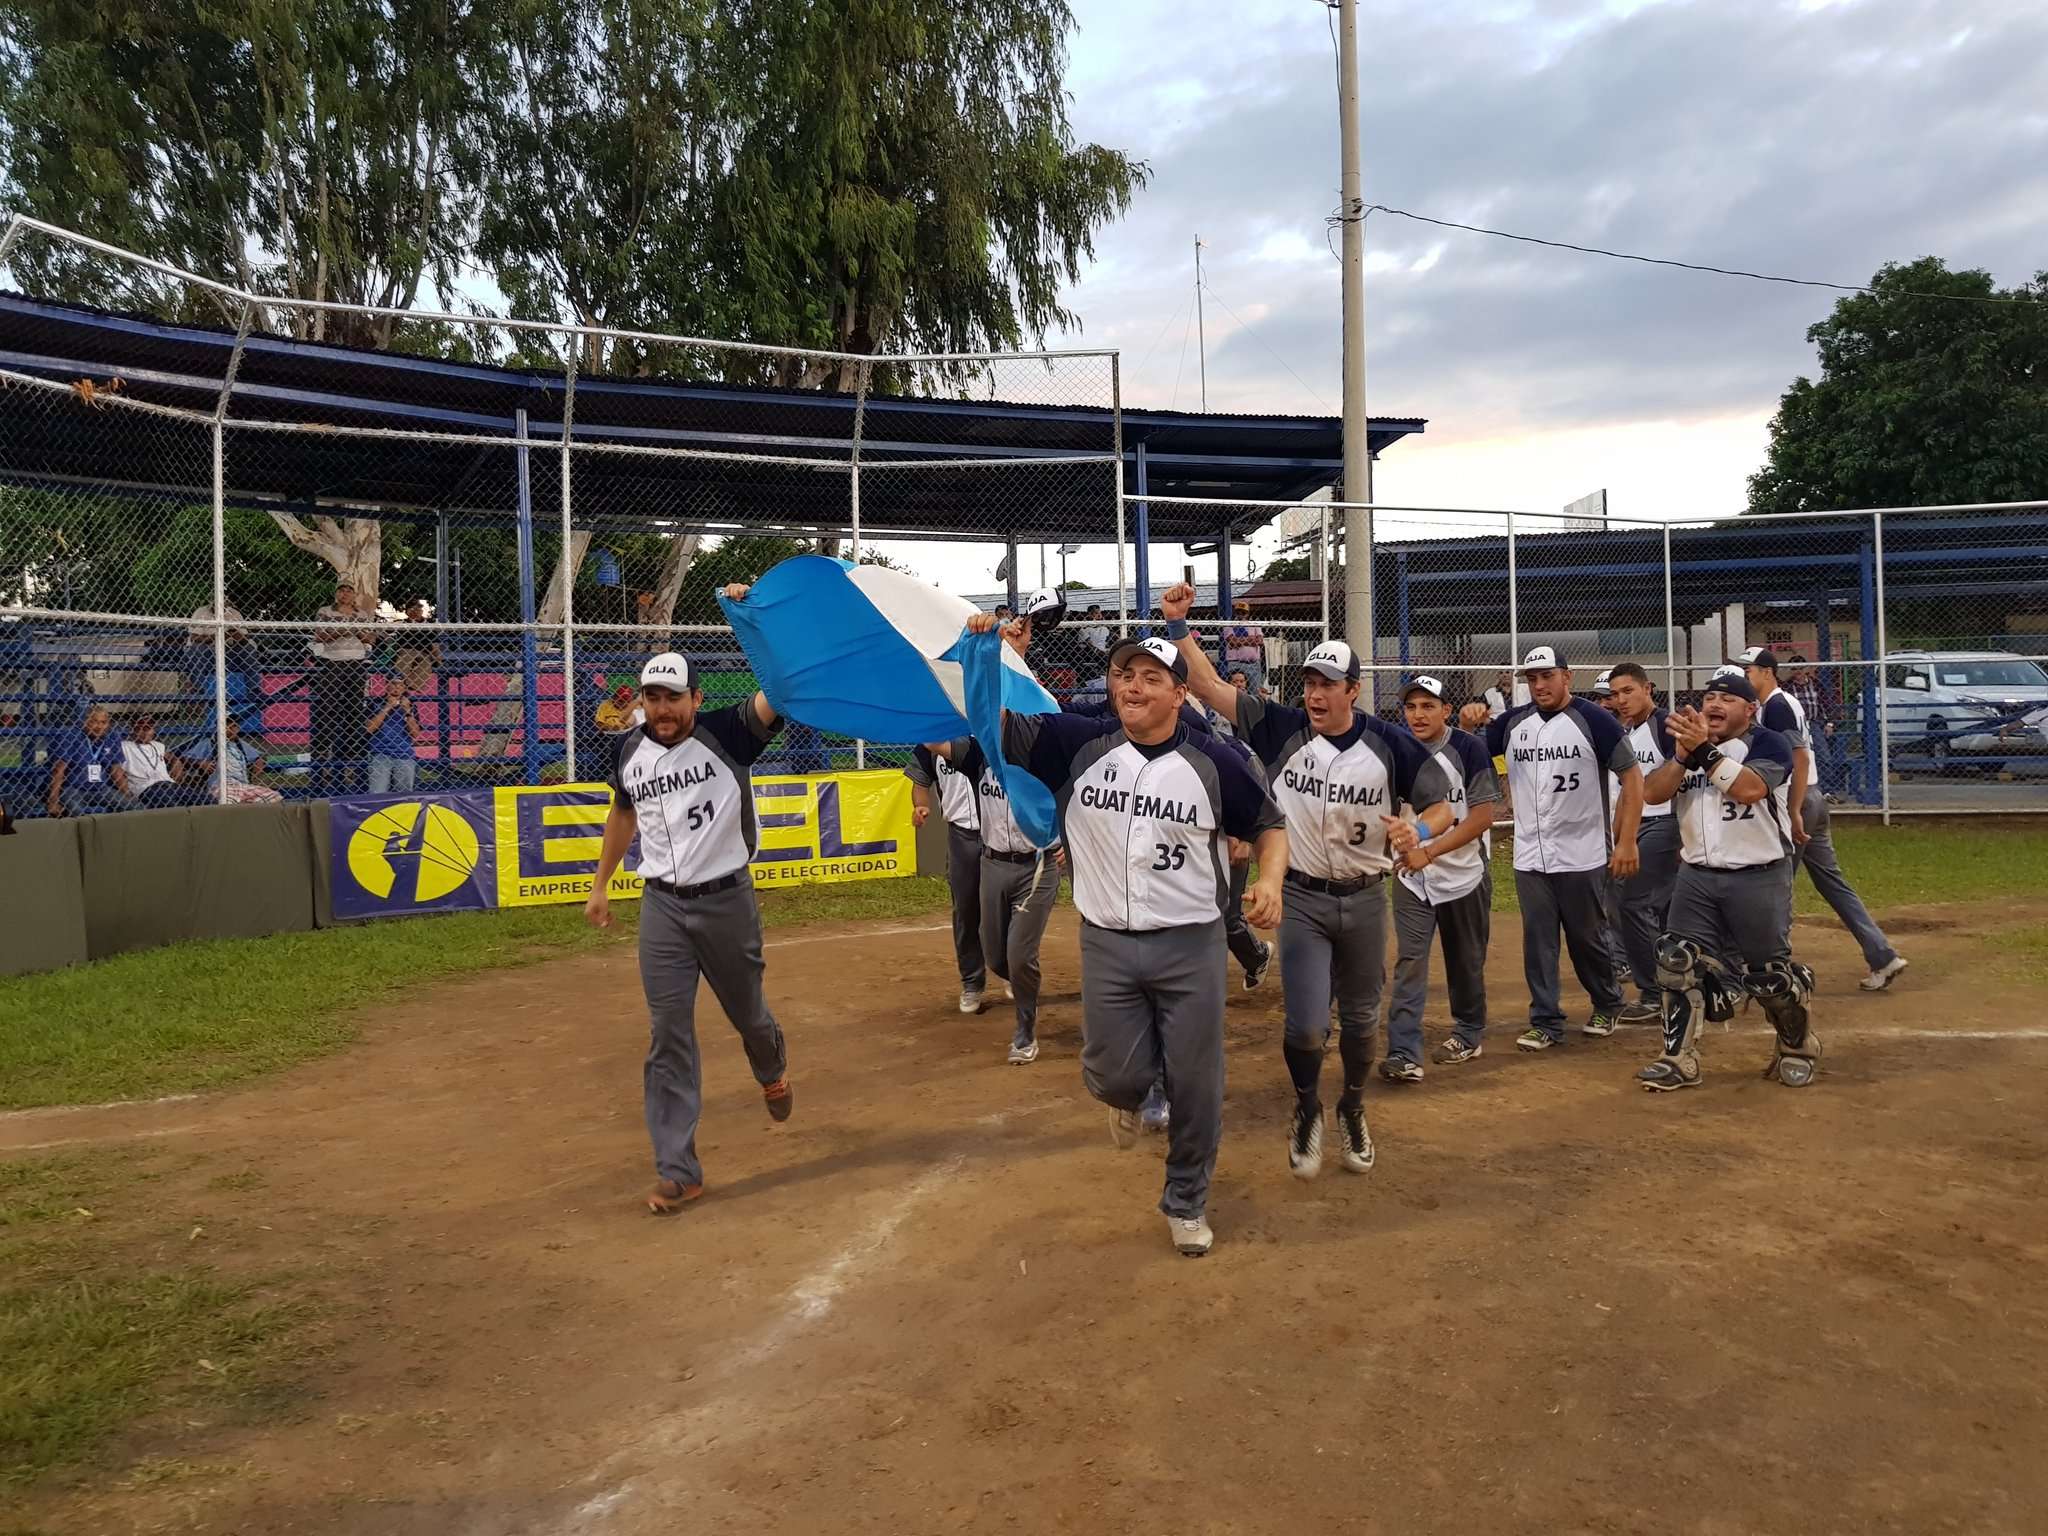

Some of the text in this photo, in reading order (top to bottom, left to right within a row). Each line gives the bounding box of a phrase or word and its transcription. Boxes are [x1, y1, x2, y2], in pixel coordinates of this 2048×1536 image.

[648, 665, 678, 676] GUA
[1309, 652, 1338, 664] GUA
[1284, 769, 1383, 806] GUATEMALA
[1552, 772, 1580, 793] 25
[687, 800, 715, 831] 51
[1080, 785, 1198, 827] GUATEMALA
[1722, 801, 1755, 821] 32
[1348, 822, 1367, 846] 3
[1152, 843, 1188, 871] 35
[519, 880, 593, 897] EMPRES
[755, 868, 777, 881] DE
[781, 858, 898, 879] ELECTRICIDAD
